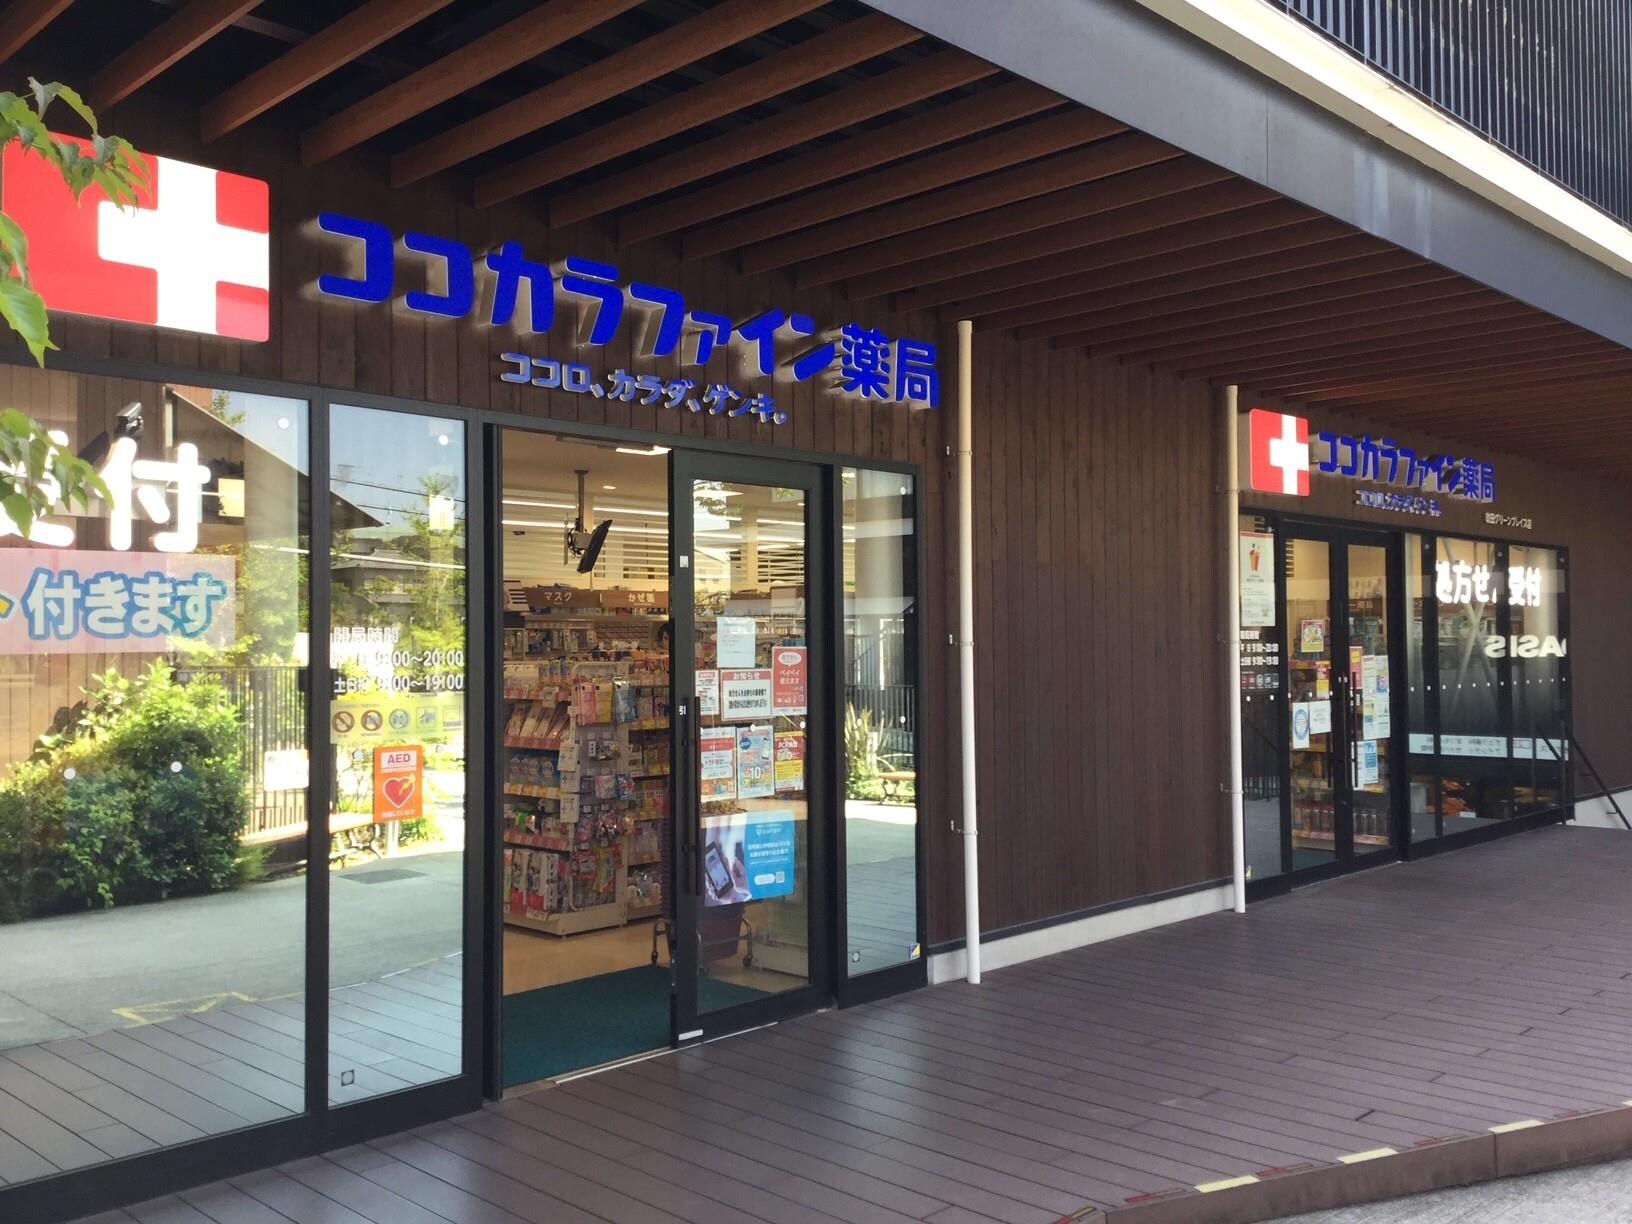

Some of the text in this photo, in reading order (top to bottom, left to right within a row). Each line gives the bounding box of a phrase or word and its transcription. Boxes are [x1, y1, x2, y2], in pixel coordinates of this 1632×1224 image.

[318, 212, 940, 410] ココカラファイン薬局
[500, 352, 788, 425] ココロ、カラダ、ゲンキ。
[1317, 431, 1496, 503] ココカラファイン薬局
[543, 591, 572, 602] マスク
[732, 672, 761, 680] お知らせ
[387, 753, 411, 764] AED
